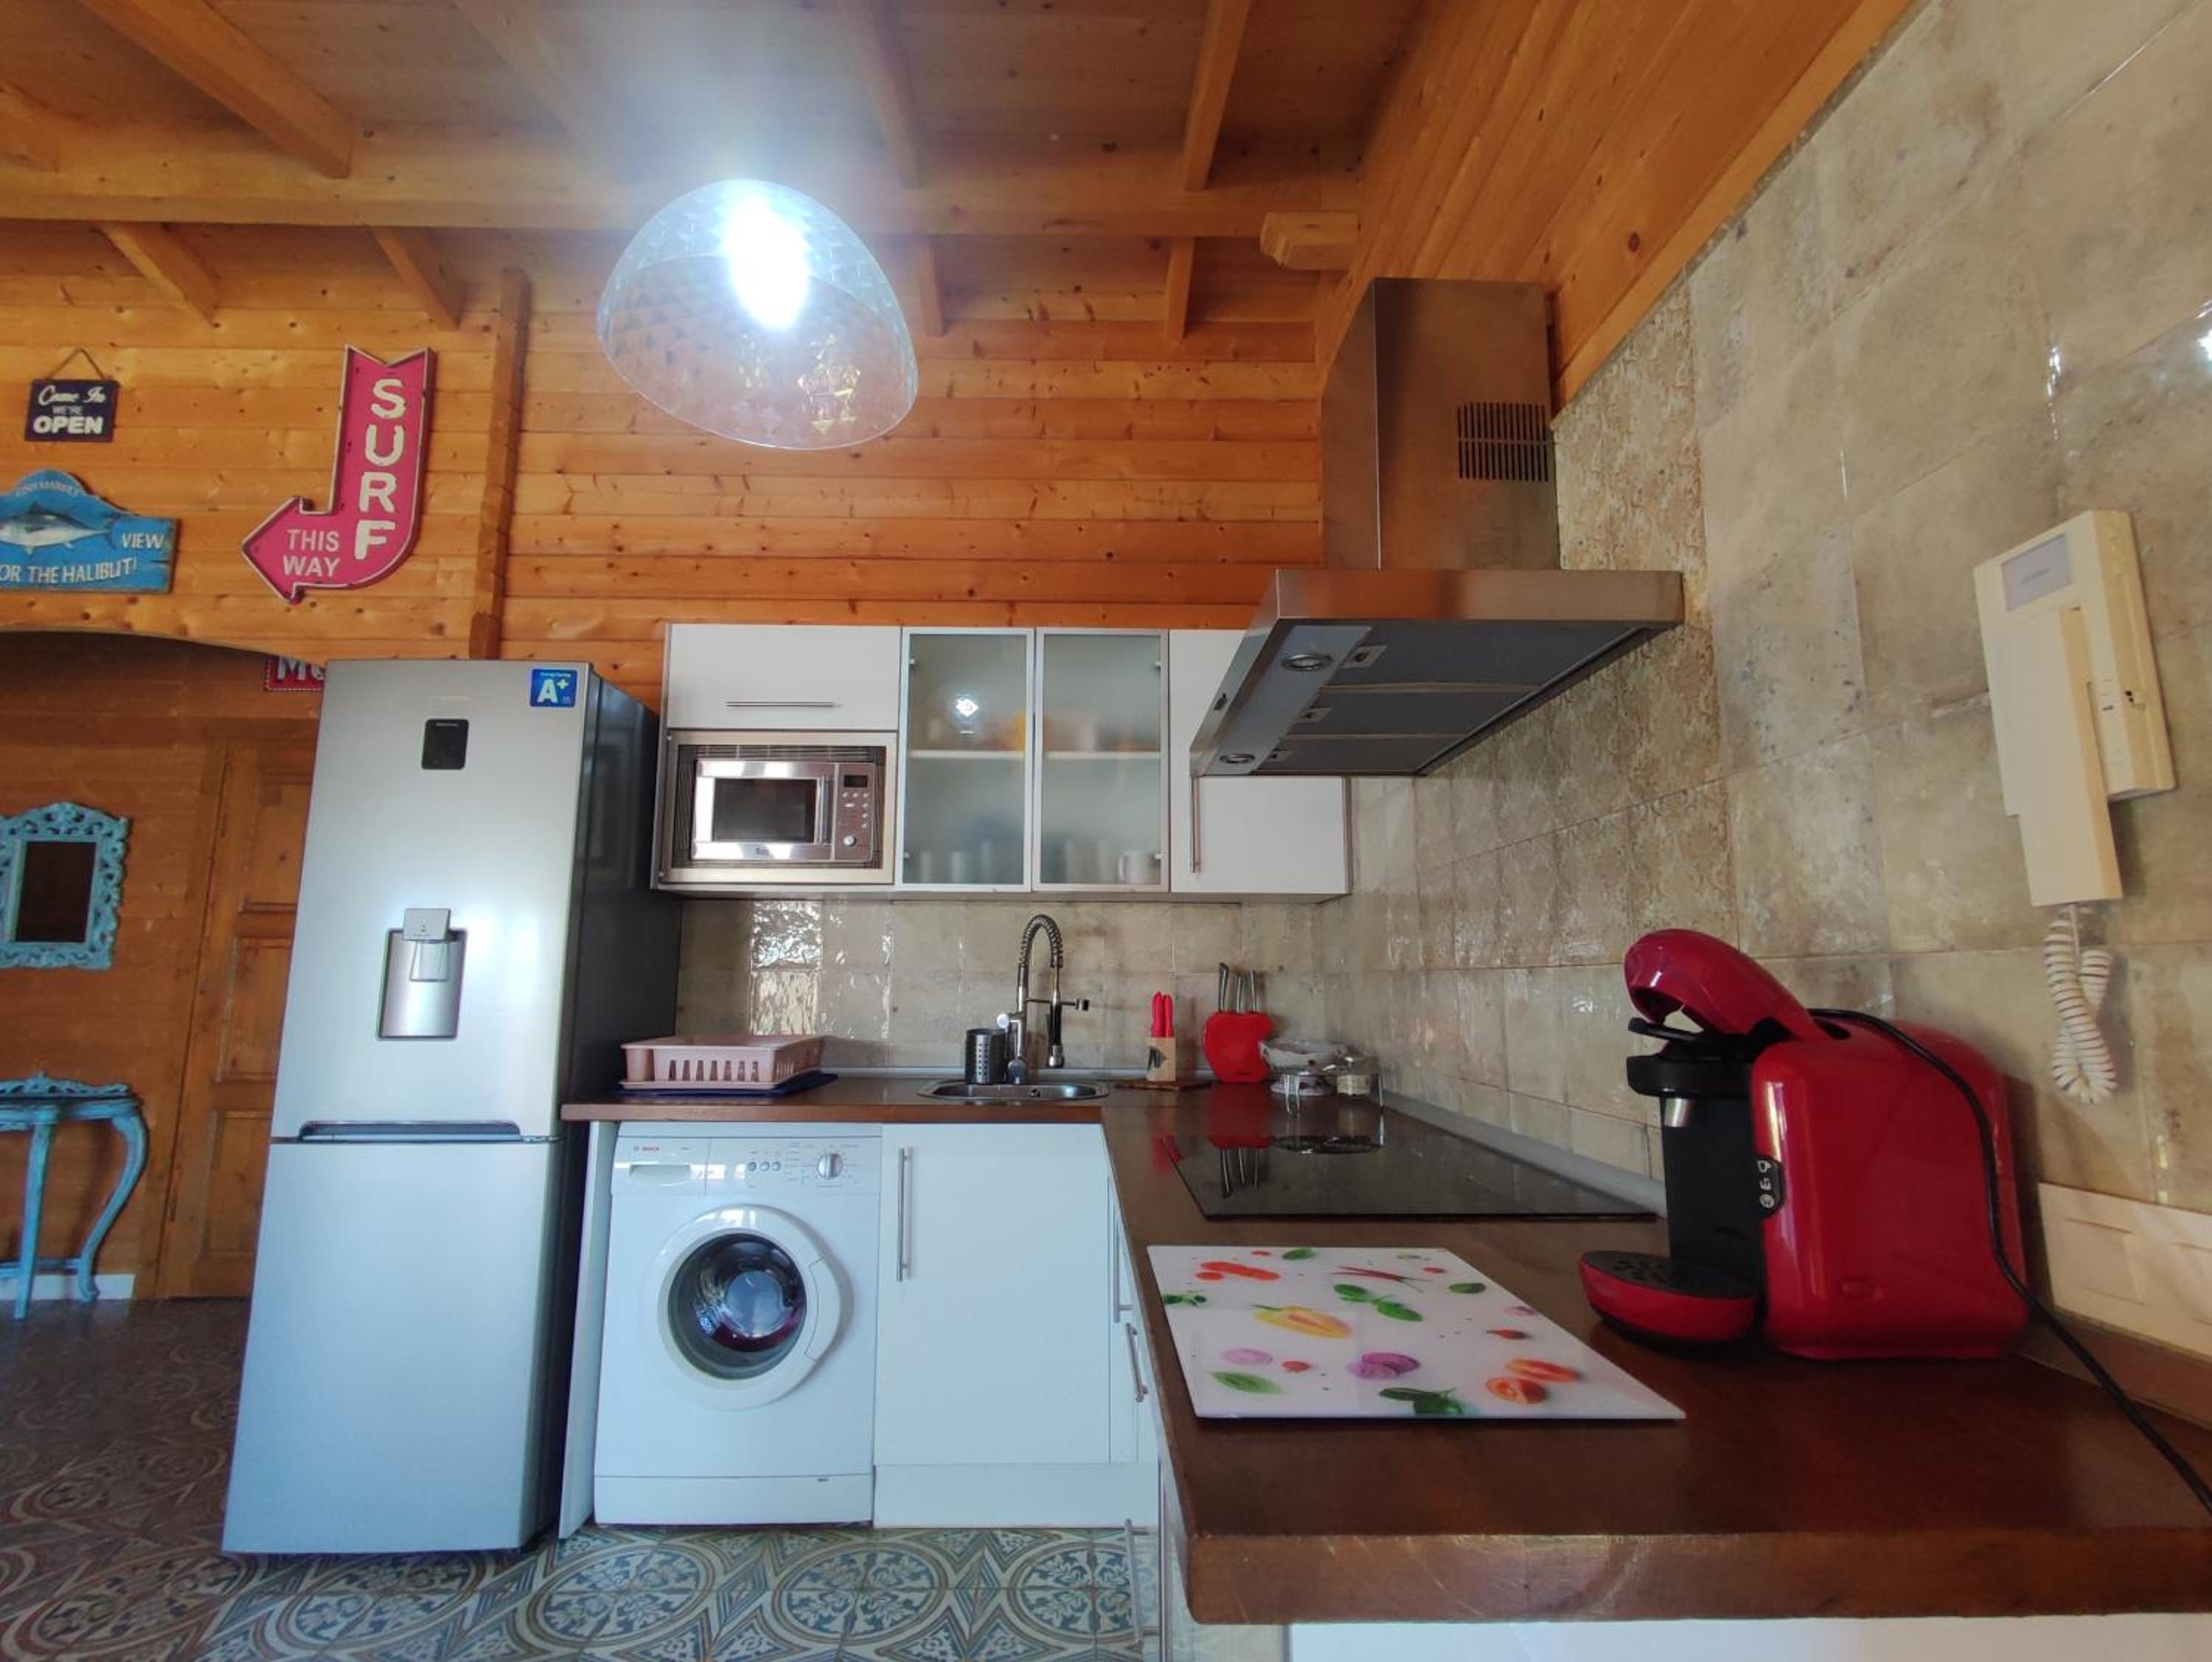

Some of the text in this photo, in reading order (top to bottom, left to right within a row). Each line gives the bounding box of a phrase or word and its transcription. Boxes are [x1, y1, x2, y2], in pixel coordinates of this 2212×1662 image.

[33, 415, 104, 434] OPEN
[354, 378, 406, 560] SURF
[122, 532, 164, 549] VIEW
[287, 529, 340, 552] THIS
[27, 566, 60, 583] THE
[62, 556, 137, 583] HALIBUT!
[282, 554, 341, 577] WAY
